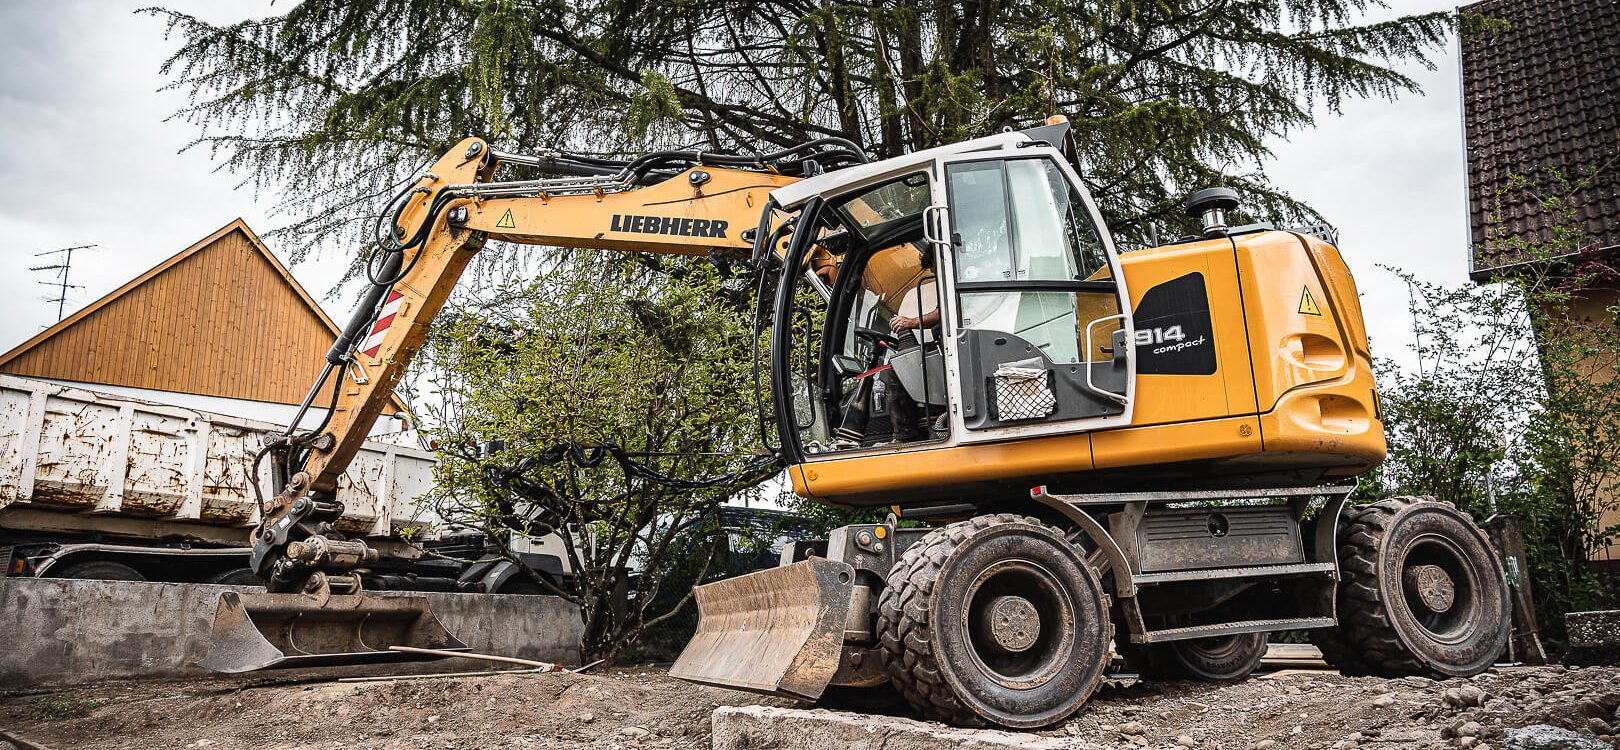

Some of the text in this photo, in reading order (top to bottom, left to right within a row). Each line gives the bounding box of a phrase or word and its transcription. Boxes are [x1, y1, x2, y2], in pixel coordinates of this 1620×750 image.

[610, 214, 728, 238] LIEBHERR
[1135, 325, 1186, 346] 914
[1153, 335, 1206, 354] compact
